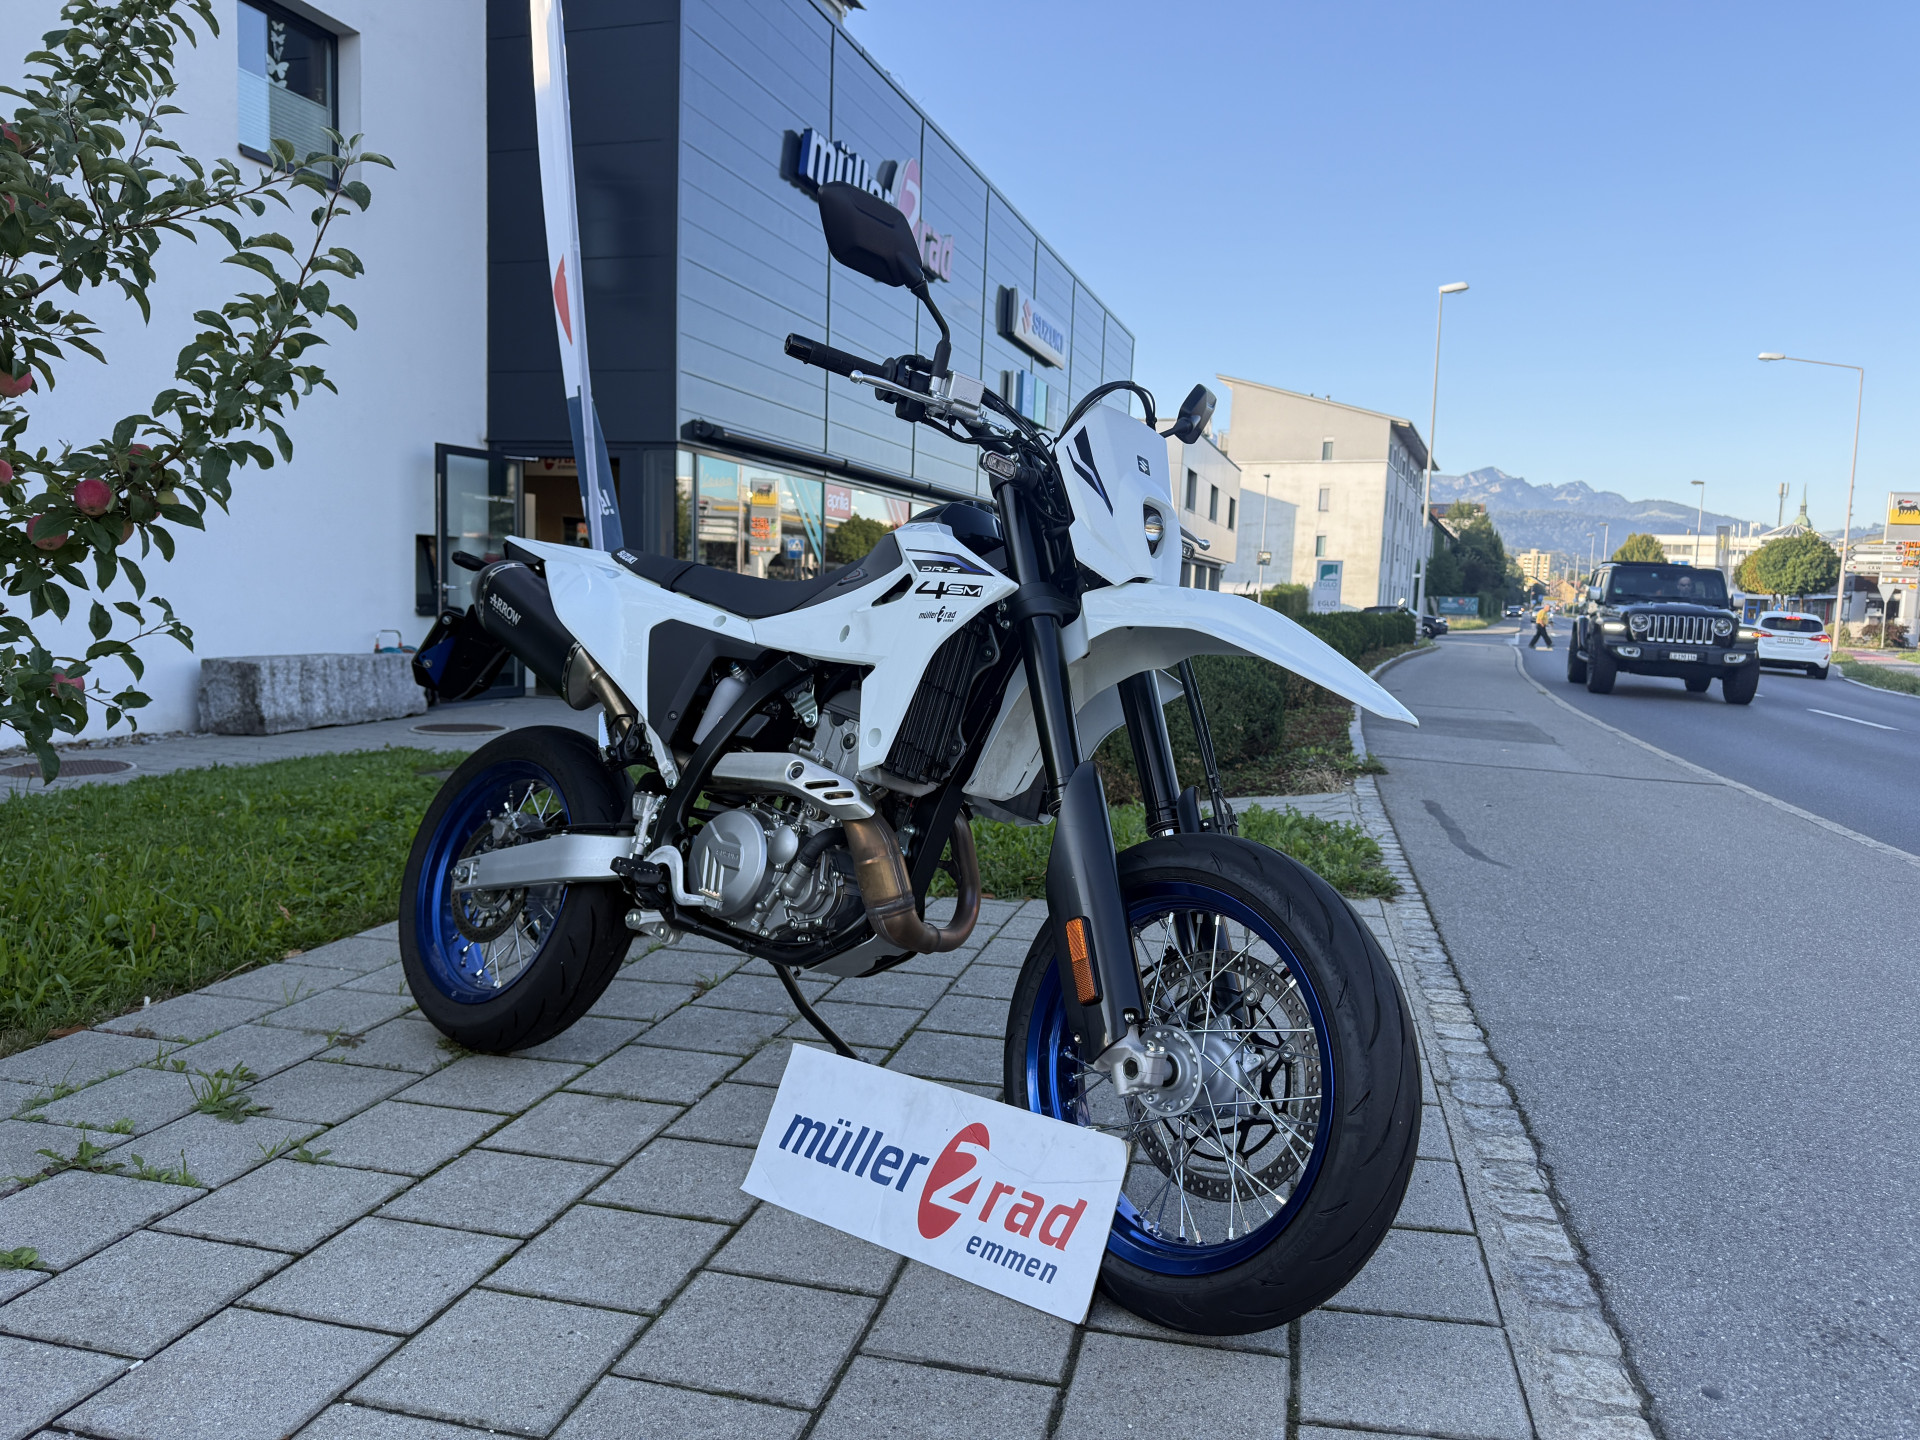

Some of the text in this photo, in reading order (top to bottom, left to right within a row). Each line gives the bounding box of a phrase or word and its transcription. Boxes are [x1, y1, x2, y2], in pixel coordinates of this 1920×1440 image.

[1031, 312, 1064, 355] SUZUKI
[827, 491, 849, 512] aprilia
[920, 565, 961, 573] DR-Z
[489, 593, 522, 626] ARROW
[778, 1113, 930, 1193] müller
[965, 1233, 1058, 1285] emmen
